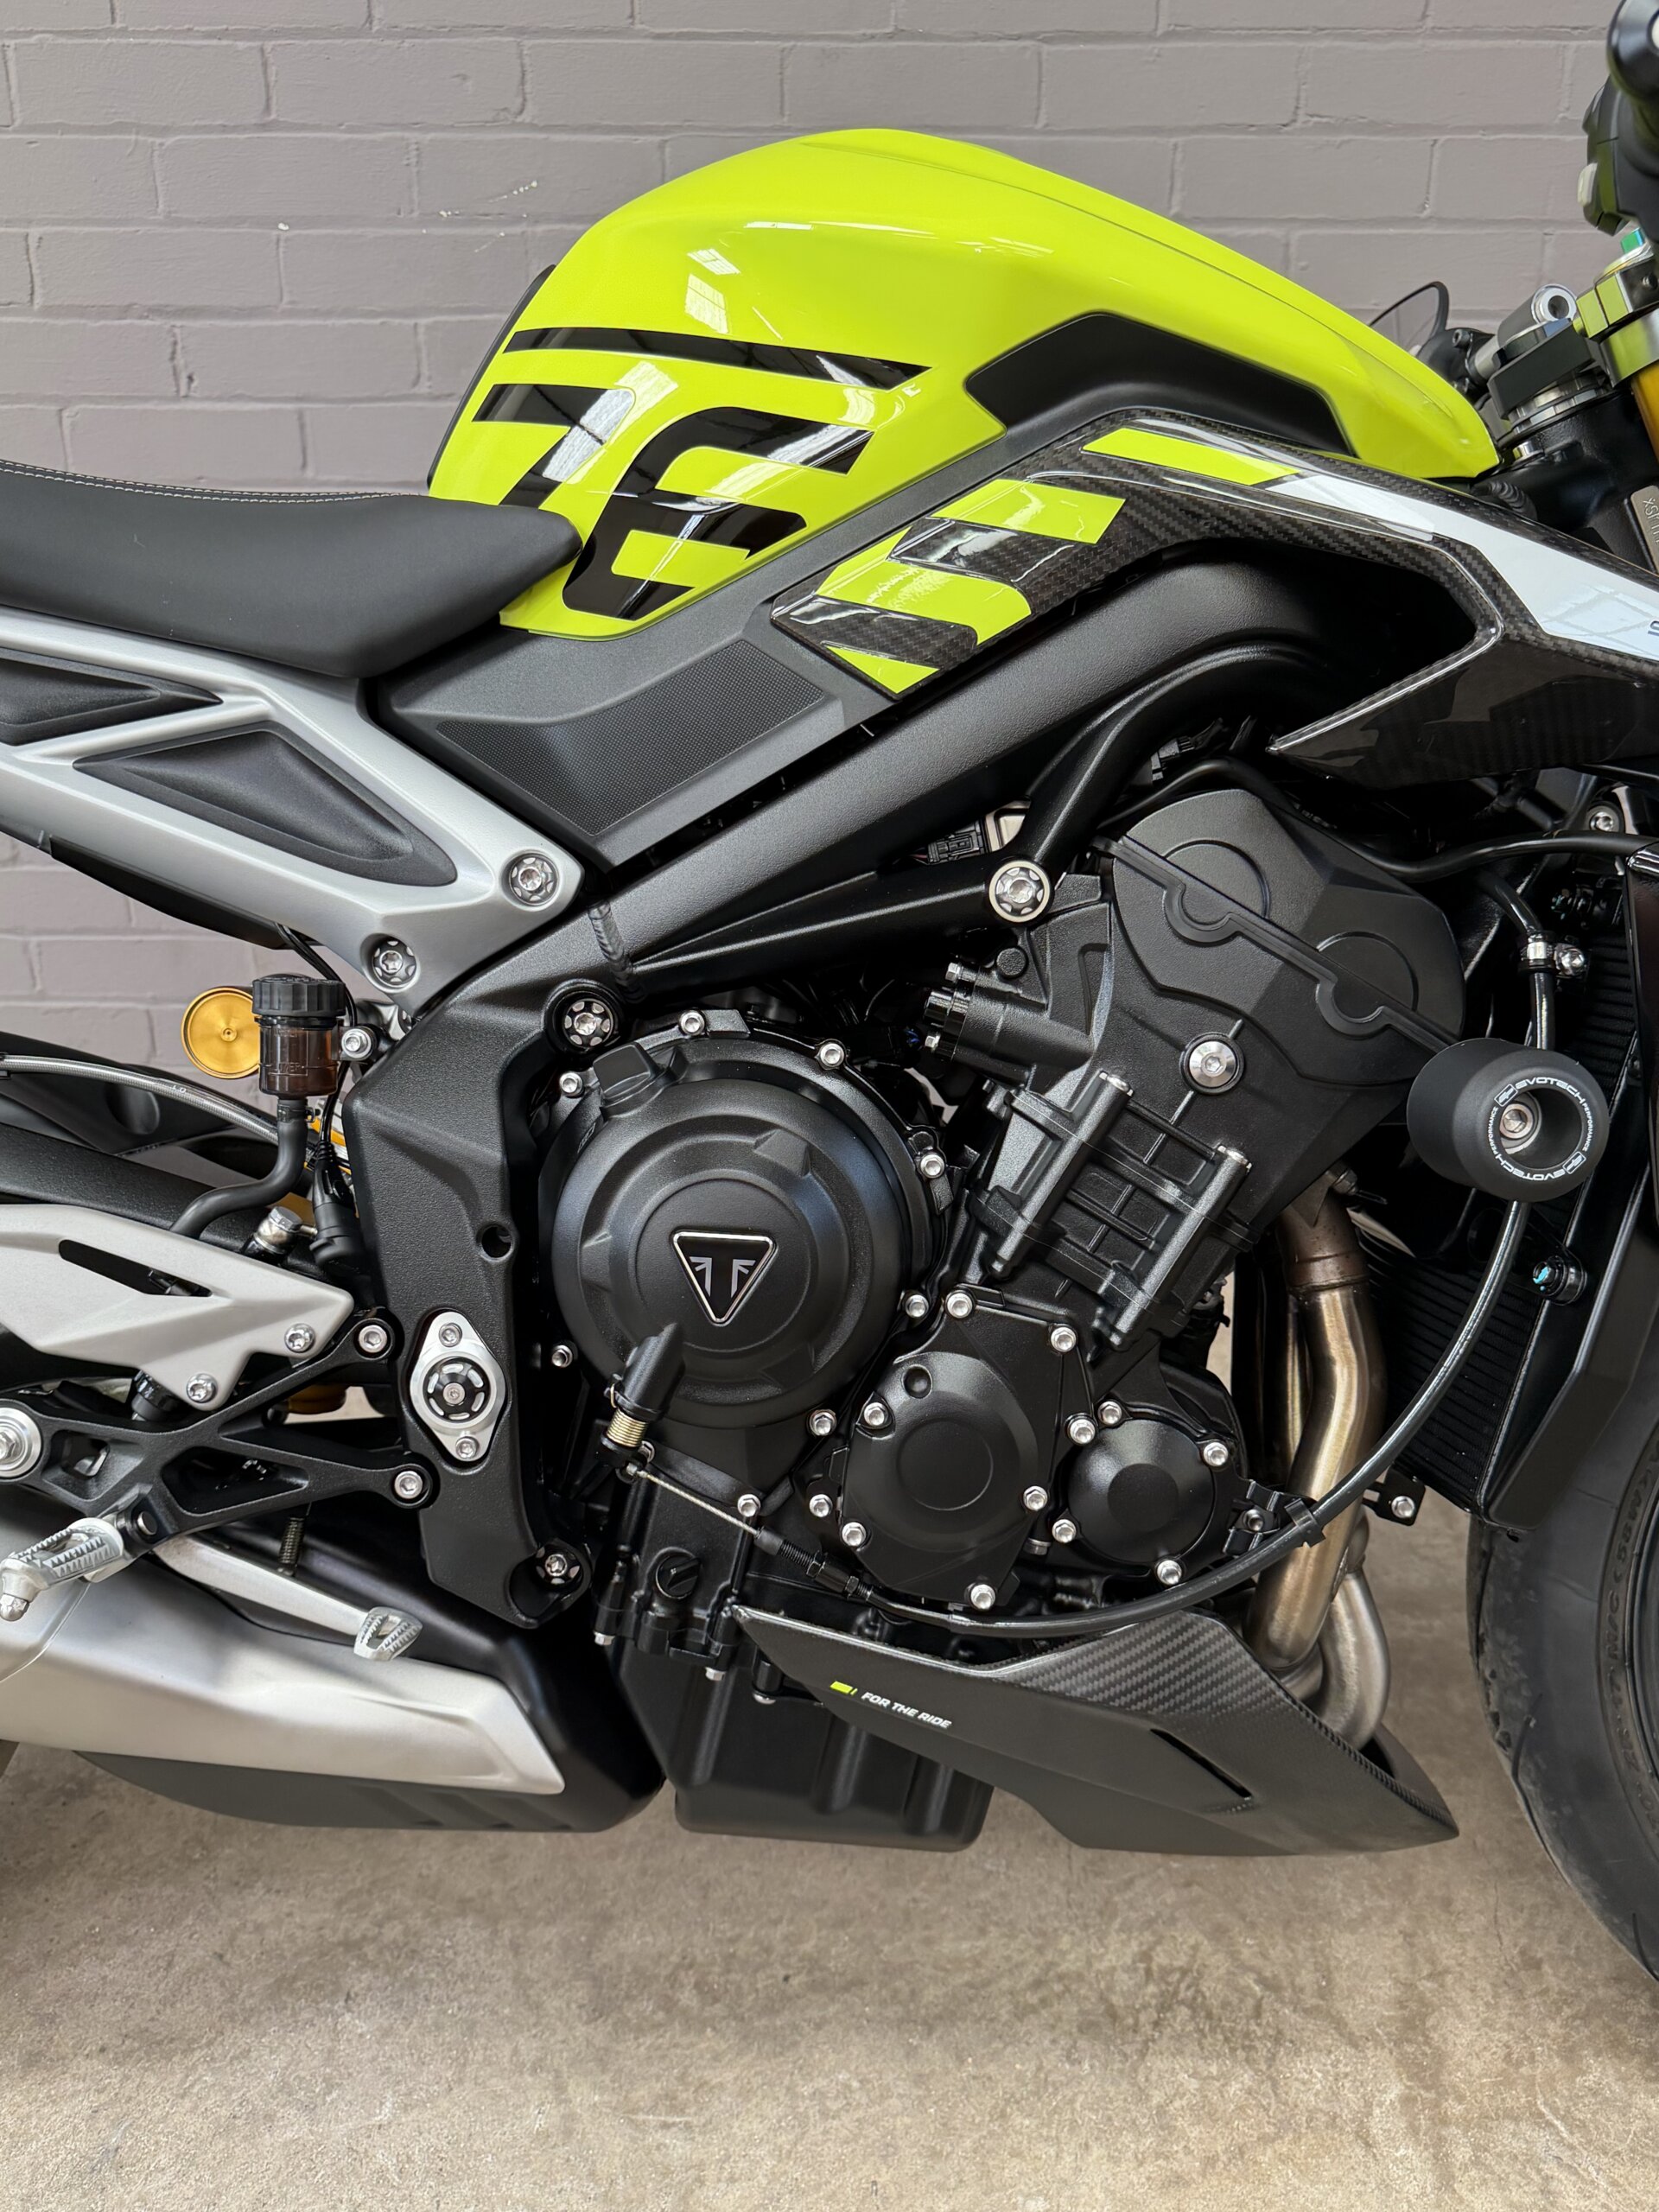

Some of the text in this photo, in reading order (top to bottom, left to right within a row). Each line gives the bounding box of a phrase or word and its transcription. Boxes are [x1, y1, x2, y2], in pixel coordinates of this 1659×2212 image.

[1487, 1106, 1499, 1155] PERFORMANCE
[1515, 1077, 1593, 1152] EVOTECH PERFORMANCE
[861, 1692, 952, 1729] FOR THE RIDE
